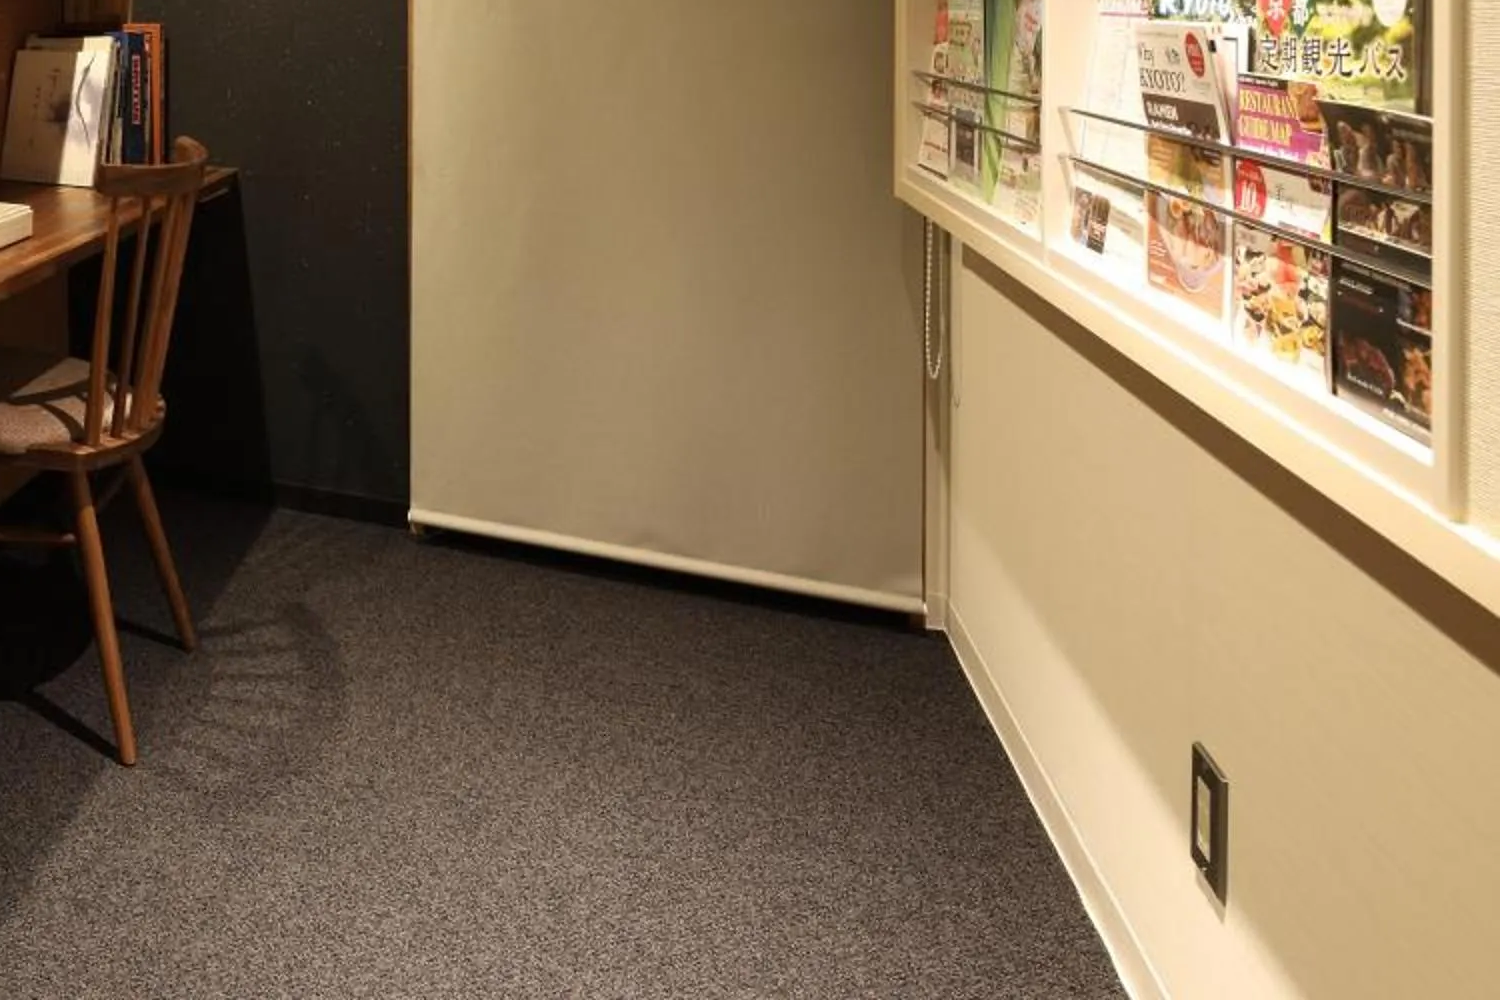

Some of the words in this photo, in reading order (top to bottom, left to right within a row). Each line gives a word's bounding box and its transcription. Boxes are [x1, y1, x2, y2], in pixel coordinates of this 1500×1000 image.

[1259, 35, 1406, 79] 定期観光バス
